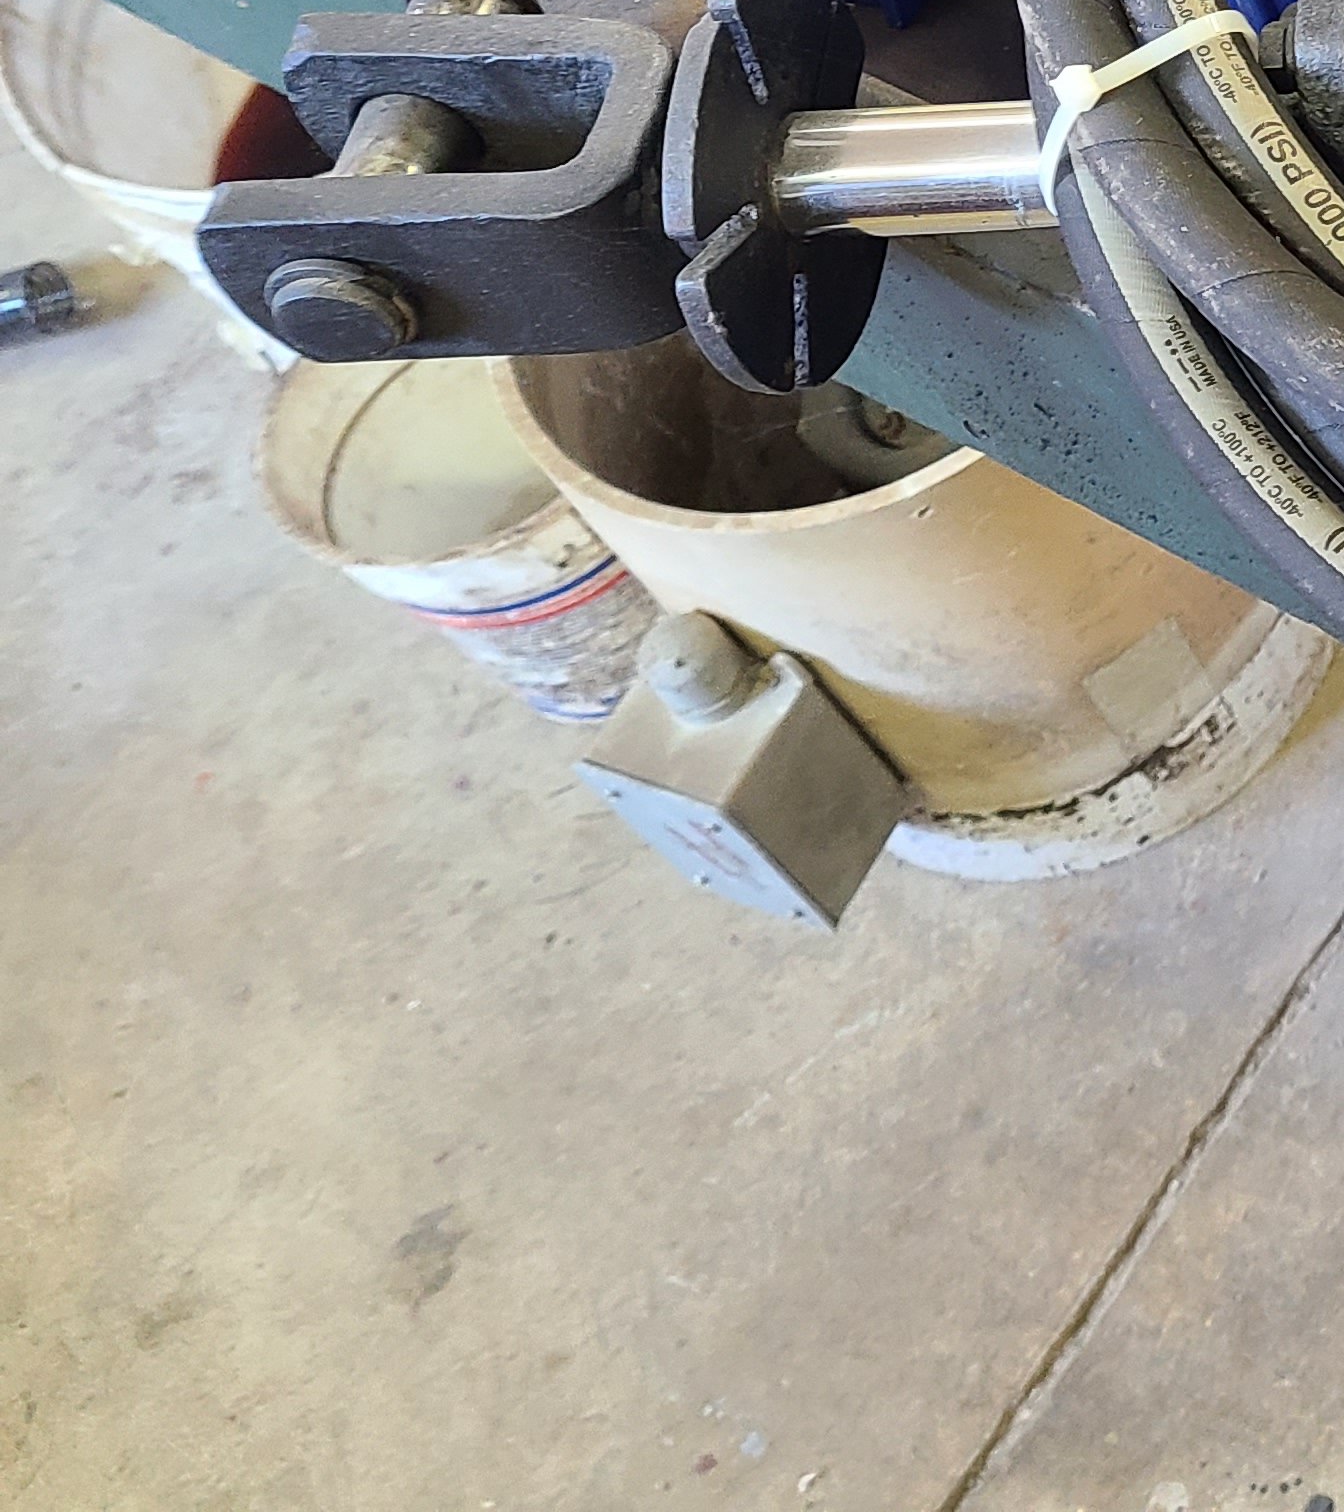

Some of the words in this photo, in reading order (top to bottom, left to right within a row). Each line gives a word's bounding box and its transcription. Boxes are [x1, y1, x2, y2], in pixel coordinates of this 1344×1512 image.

[1195, 44, 1216, 68] TO
[1219, 40, 1238, 61] TO
[1250, 119, 1316, 187] PSI)
[1165, 314, 1187, 341] USA
[1180, 339, 1197, 355] IN
[1189, 353, 1218, 388] MADE
[1249, 464, 1275, 487] TO
[1271, 453, 1296, 476] TO
